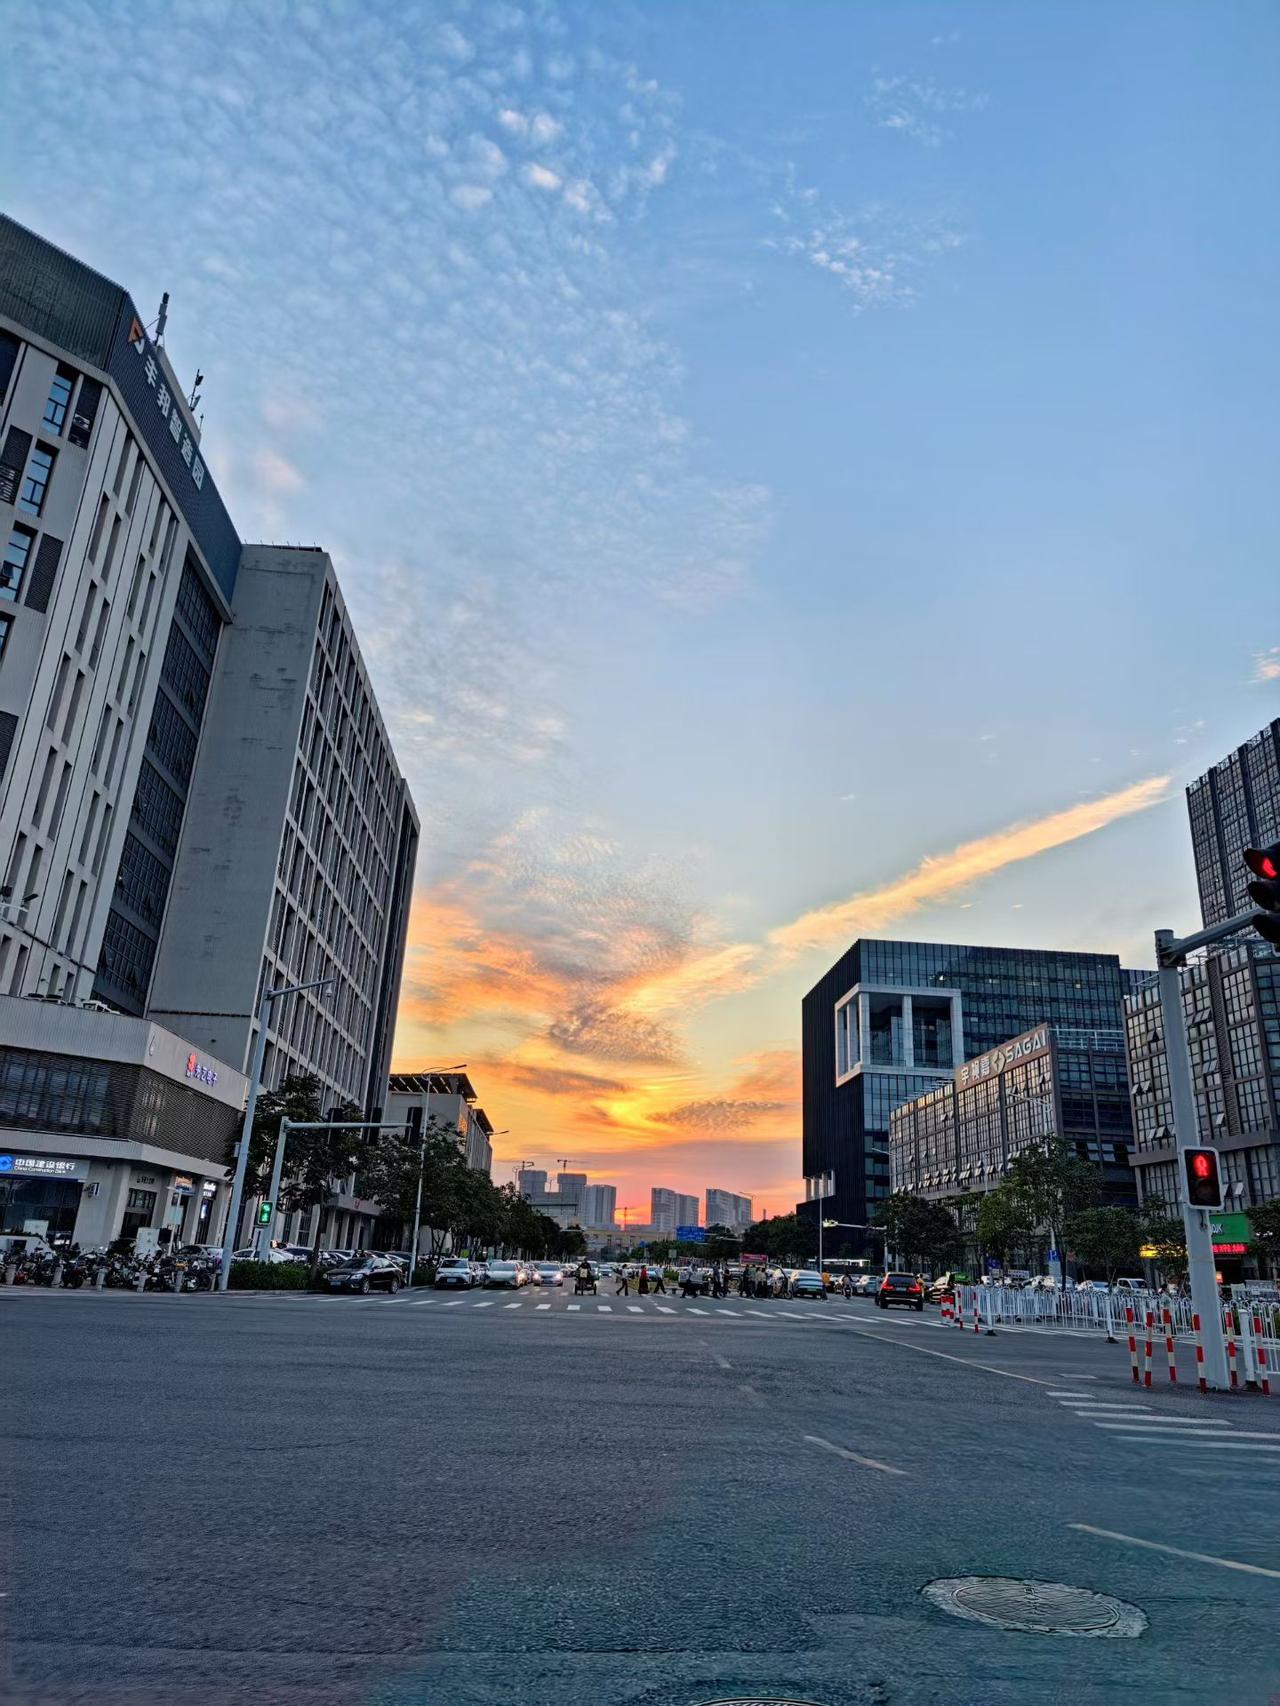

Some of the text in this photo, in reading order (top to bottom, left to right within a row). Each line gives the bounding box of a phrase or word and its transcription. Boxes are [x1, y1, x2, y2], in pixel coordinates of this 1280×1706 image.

[15, 1158, 76, 1171] 中国建设银行
